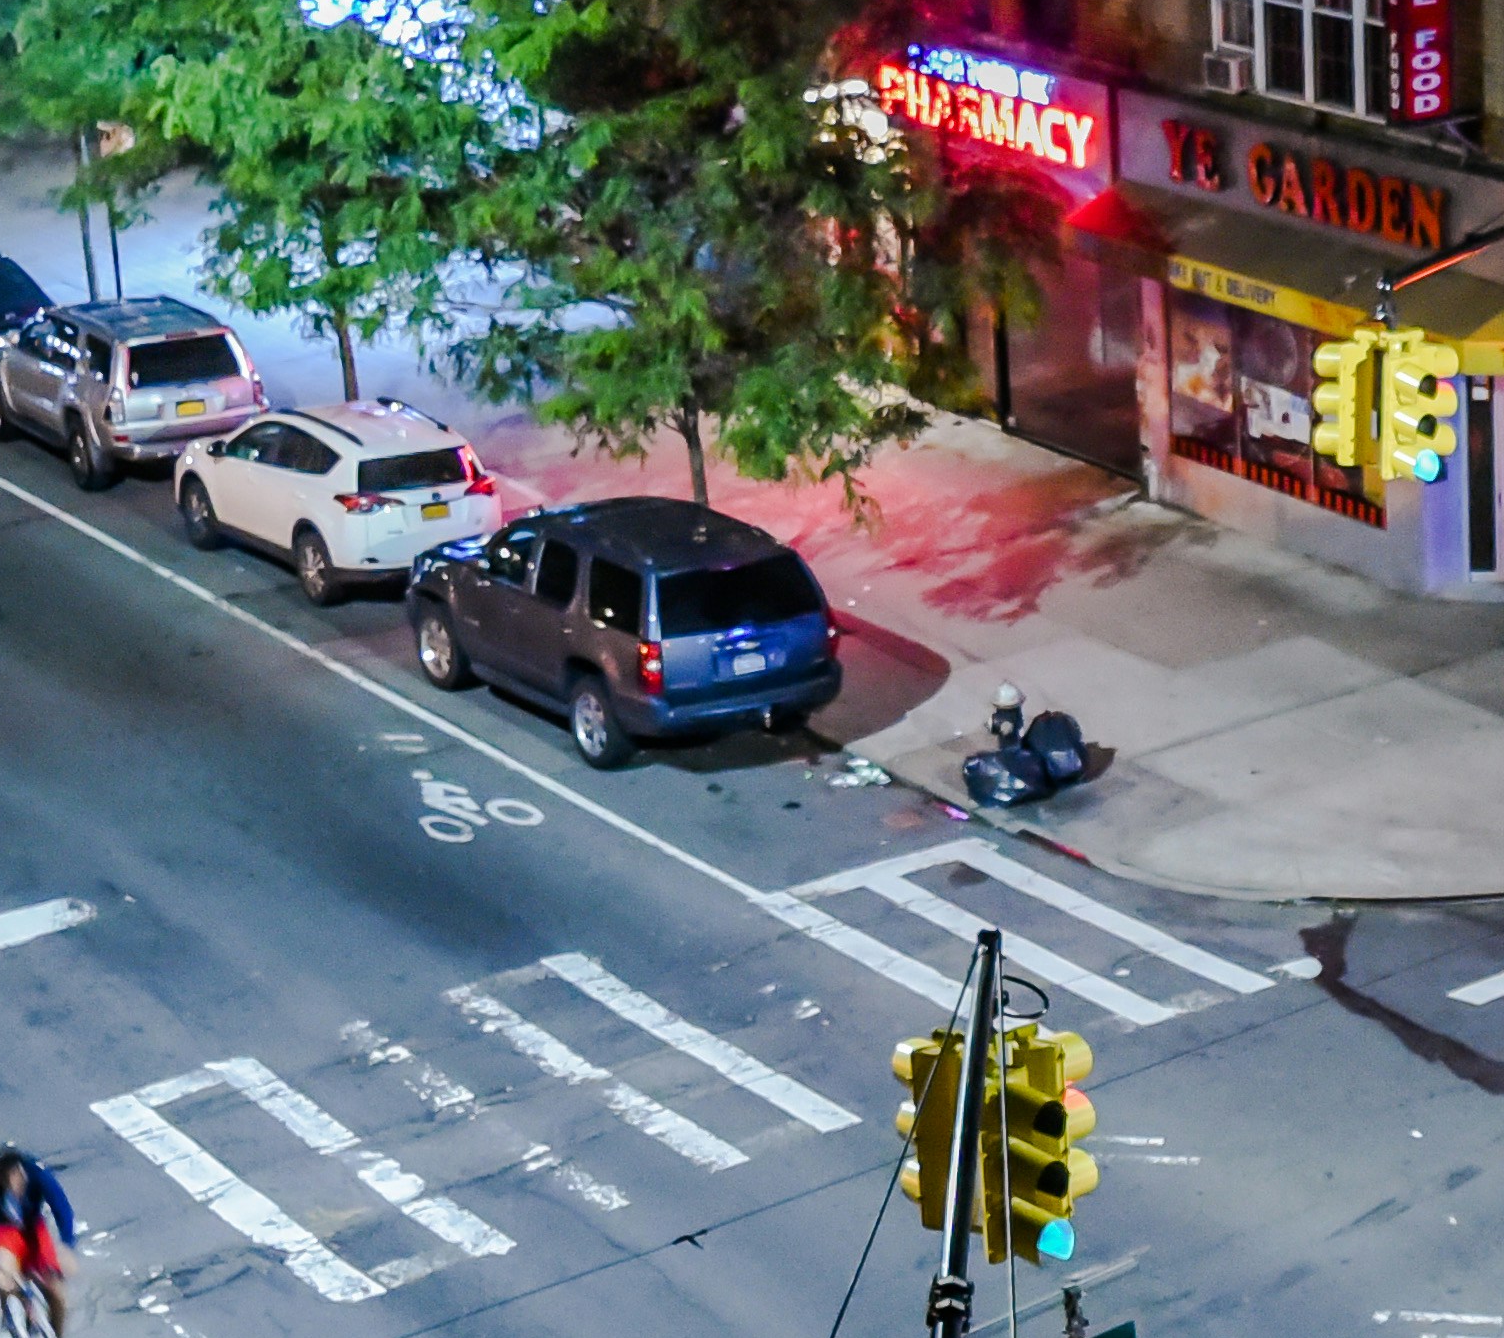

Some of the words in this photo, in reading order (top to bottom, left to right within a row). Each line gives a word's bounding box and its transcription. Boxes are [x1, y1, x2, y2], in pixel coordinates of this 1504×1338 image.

[880, 64, 1094, 169] PHARMACY
[1411, 29, 1442, 113] FOOD
[1161, 118, 1221, 193] YE
[1246, 141, 1445, 251] GARDEN
